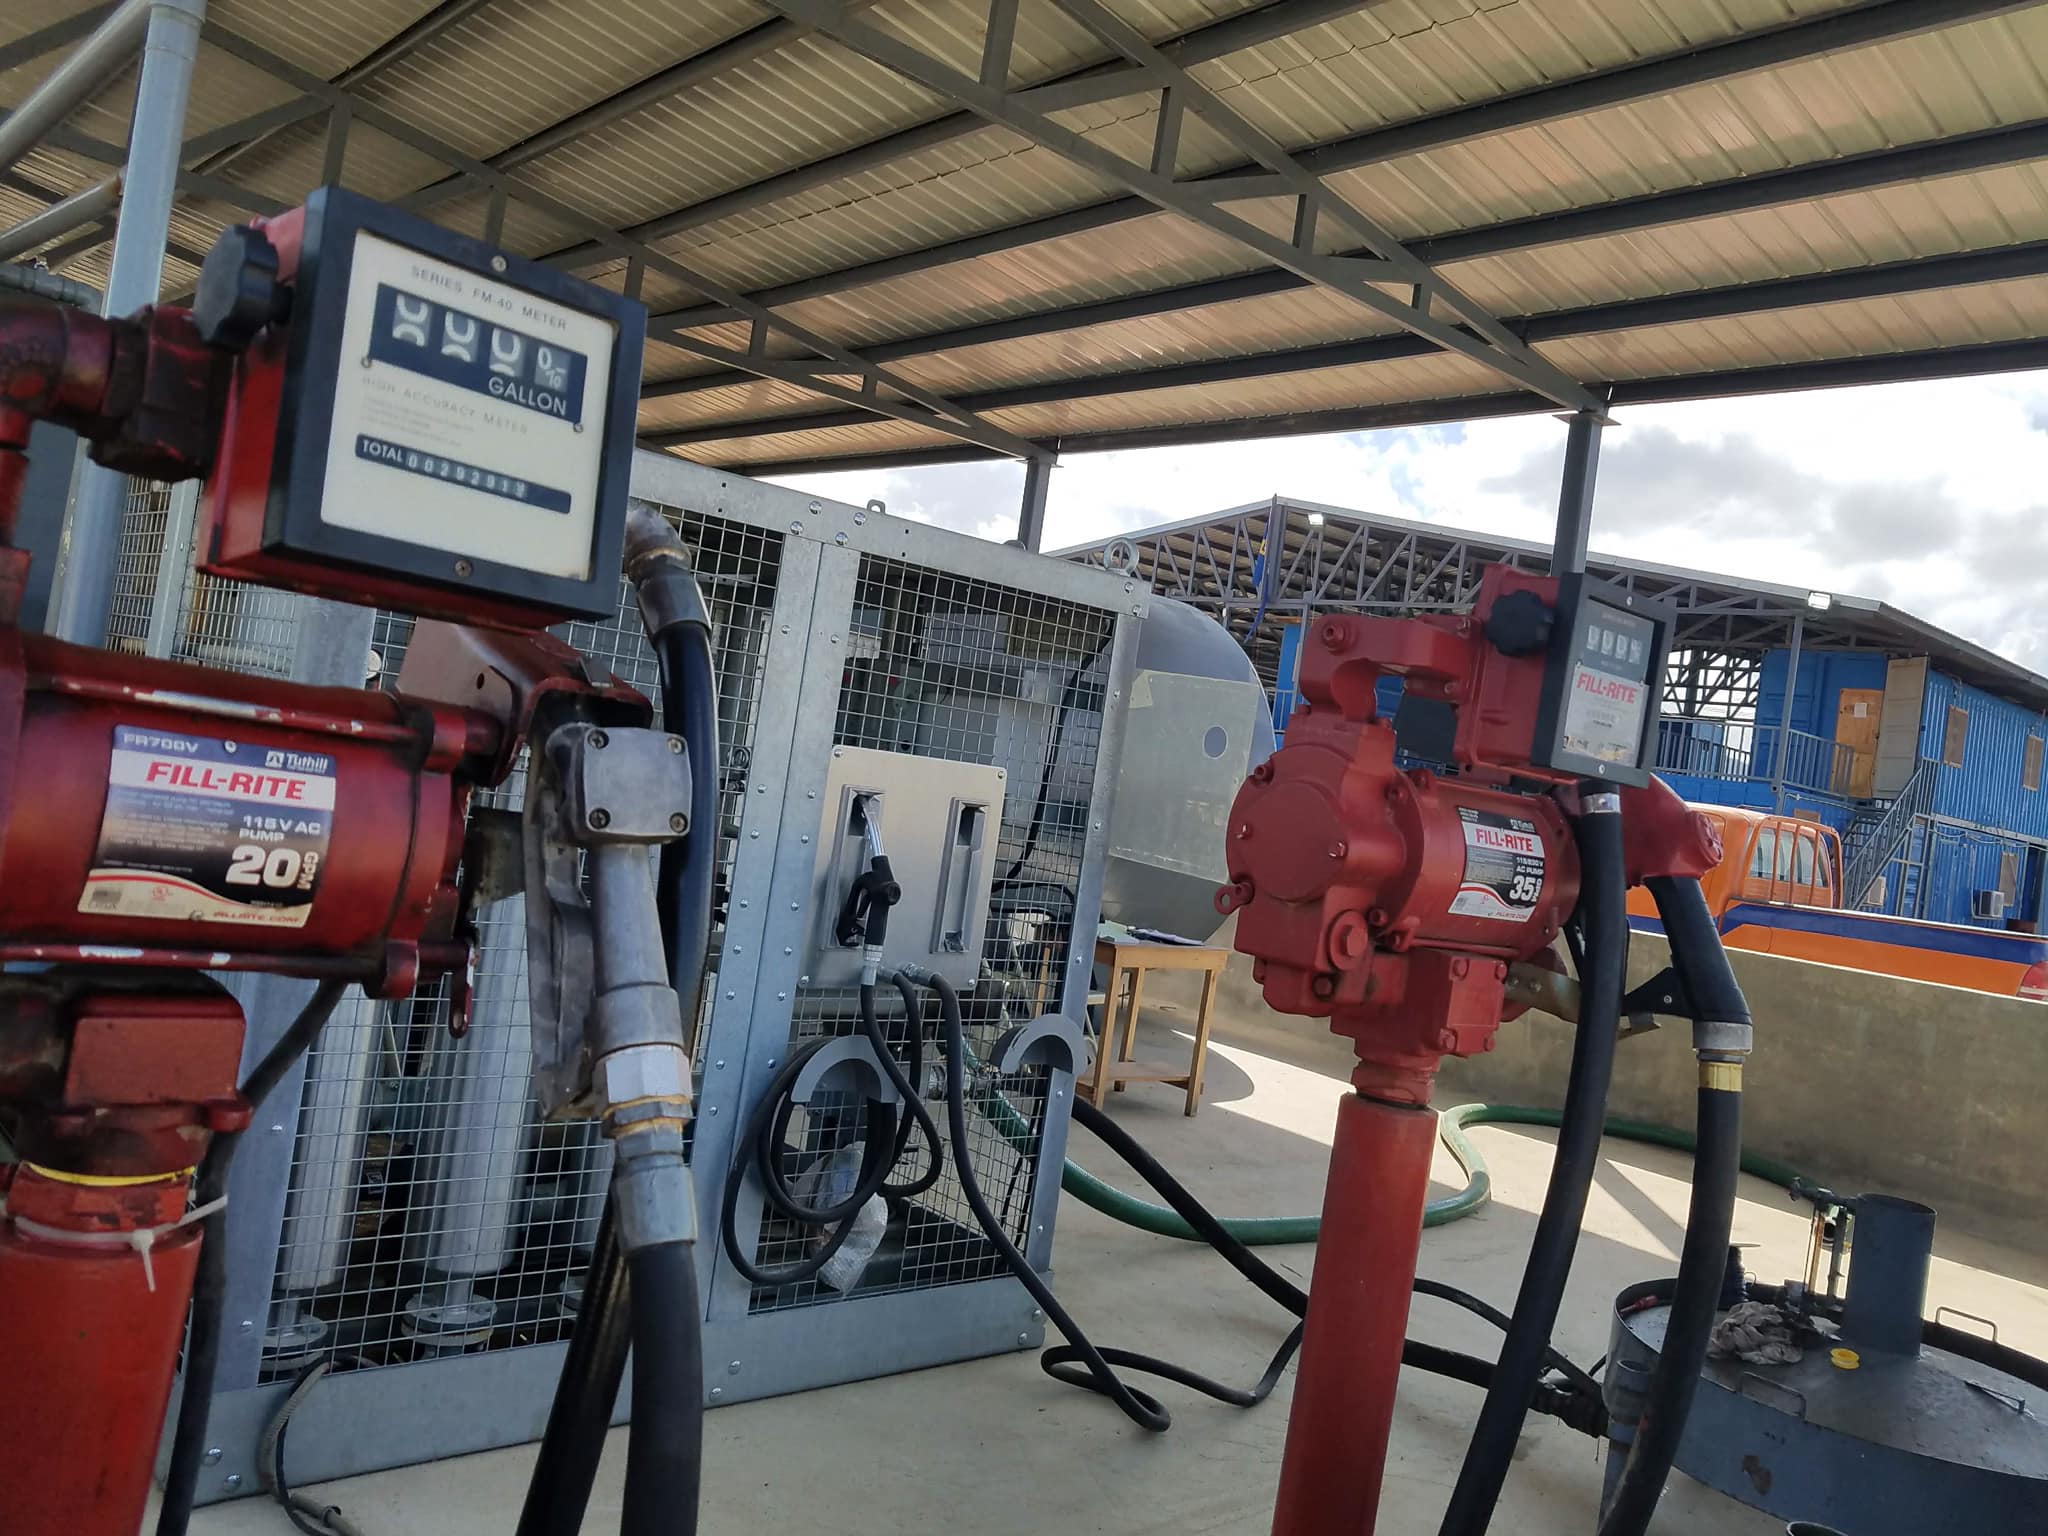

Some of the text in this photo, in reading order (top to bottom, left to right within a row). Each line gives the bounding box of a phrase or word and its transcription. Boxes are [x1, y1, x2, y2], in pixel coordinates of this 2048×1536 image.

[411, 265, 568, 330] SERIES FM-40 METER
[488, 376, 568, 417] GALLON
[362, 439, 403, 463] TOTAL
[1576, 672, 1639, 704] FILL-RITE
[285, 752, 329, 771] Tuthill
[146, 760, 307, 801] FILL-RITE
[239, 827, 285, 843] PUMP
[294, 819, 321, 836] AC
[1475, 828, 1534, 852] FILL-RITE
[225, 844, 319, 891] 20 GPM
[1509, 875, 1536, 901] 35
